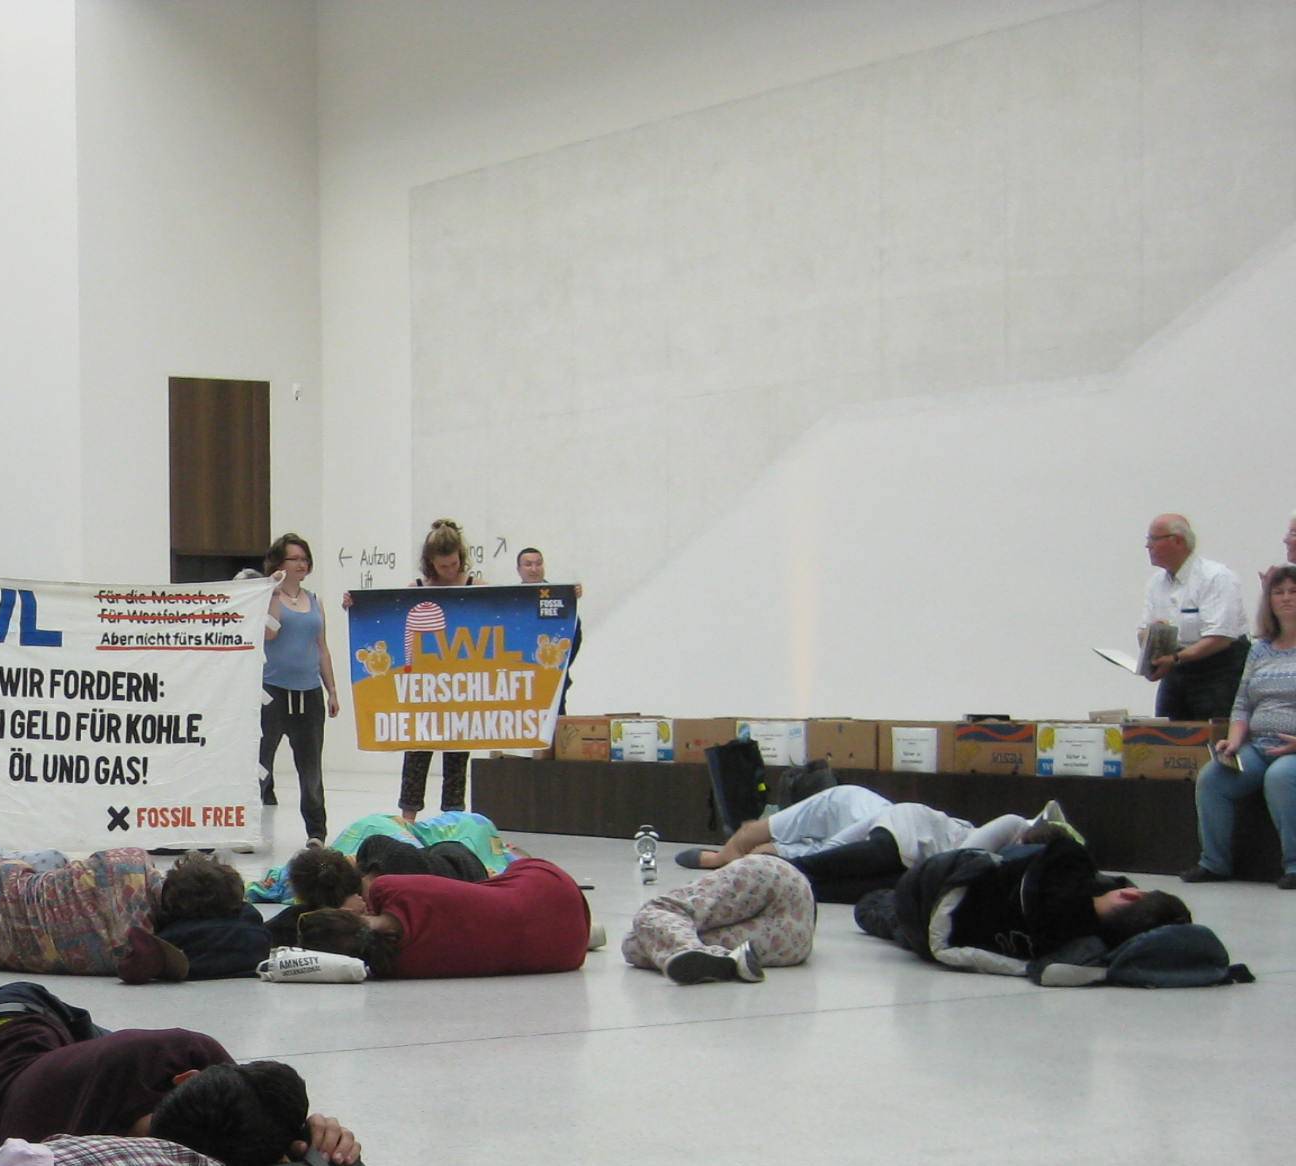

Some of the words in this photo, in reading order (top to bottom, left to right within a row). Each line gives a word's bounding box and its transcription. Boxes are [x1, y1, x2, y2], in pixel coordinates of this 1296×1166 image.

[360, 545, 396, 570] Aufzug
[360, 570, 374, 589] Lift
[98, 589, 121, 604] Für
[126, 590, 147, 604] die
[100, 608, 121, 623] Für
[100, 632, 134, 646] Aber
[135, 632, 171, 646] nicht
[173, 632, 202, 646] fürs
[412, 626, 523, 663] LWL
[49, 669, 165, 703] FORDERN:
[394, 669, 535, 703] VERSCHLÄFT
[10, 710, 71, 741] GELD
[75, 708, 122, 744] FÜR
[125, 713, 206, 747] KOHLE,
[375, 712, 411, 742] DIE
[8, 748, 38, 783] ÖL
[42, 755, 90, 784] UND
[94, 756, 148, 786] GAS!
[136, 806, 196, 828] FOSSIL
[202, 806, 245, 828] FREE
[279, 957, 319, 970] AMNESTY
